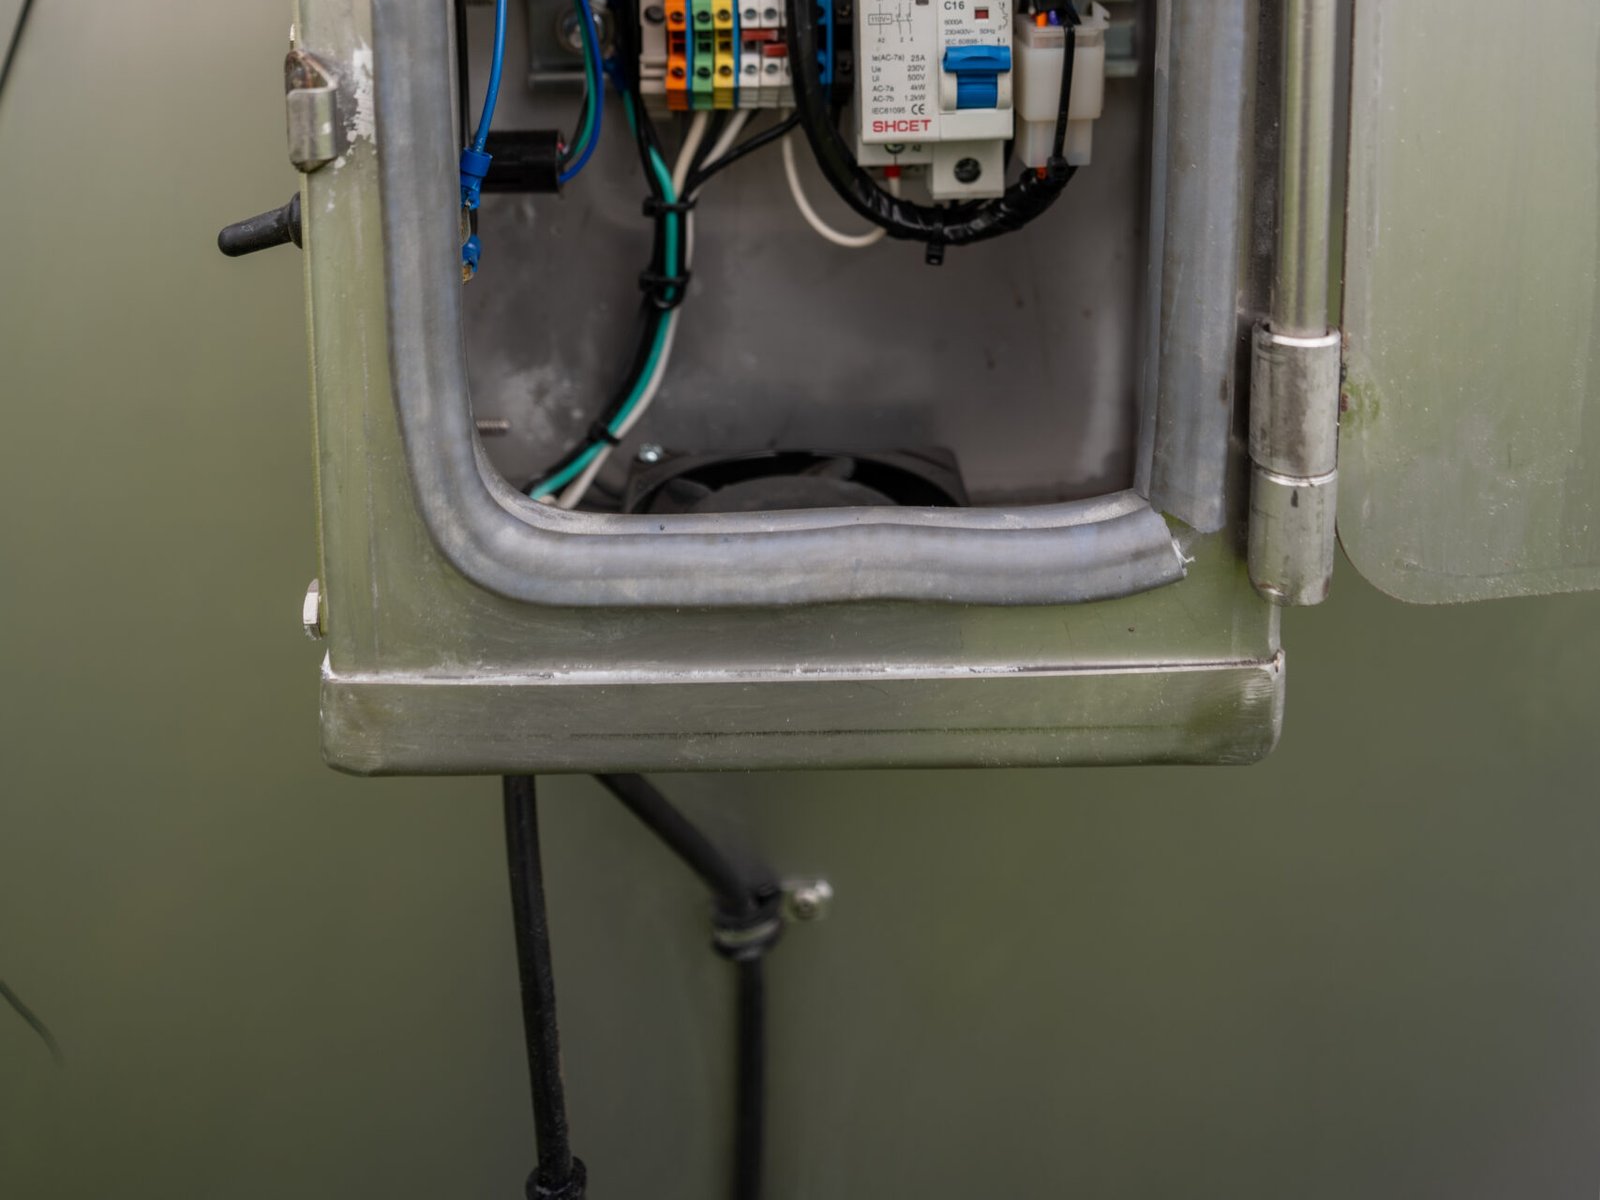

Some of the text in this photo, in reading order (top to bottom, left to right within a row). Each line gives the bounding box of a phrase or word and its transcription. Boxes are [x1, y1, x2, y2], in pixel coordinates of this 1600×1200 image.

[944, 1, 965, 11] C16
[911, 54, 926, 62] 25A
[872, 120, 931, 133] SHCET
